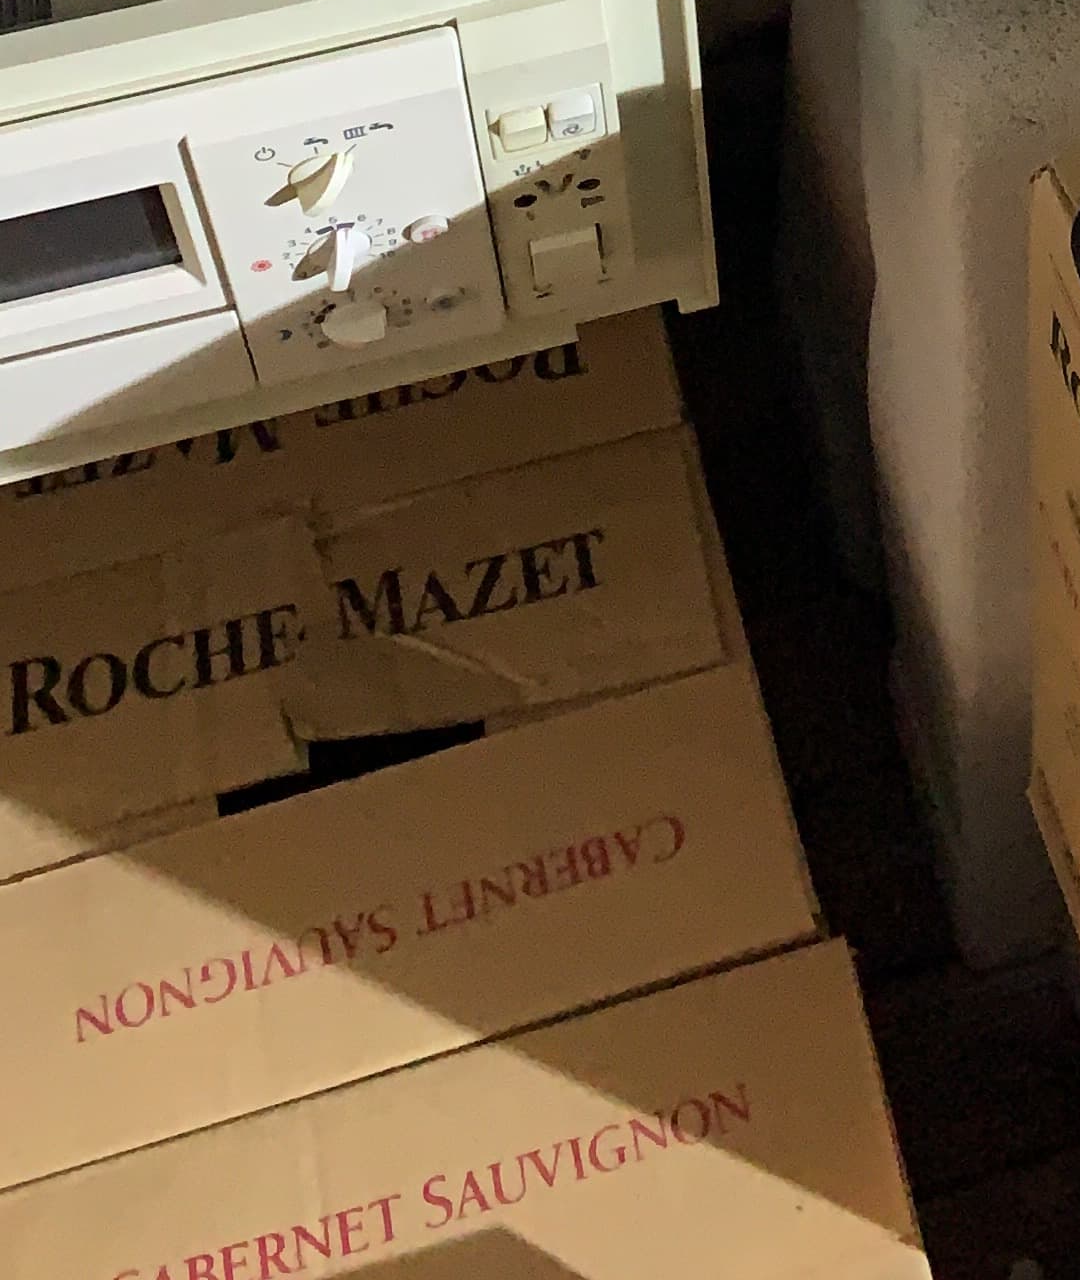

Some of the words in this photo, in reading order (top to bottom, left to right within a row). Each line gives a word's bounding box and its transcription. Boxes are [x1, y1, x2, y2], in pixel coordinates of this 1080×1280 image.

[5, 603, 307, 735] ROCHE
[329, 527, 606, 640] MAZET
[416, 815, 687, 938] CABERNET
[74, 903, 398, 1043] SAUVIGNON
[423, 1082, 752, 1230] SAUVIGNON
